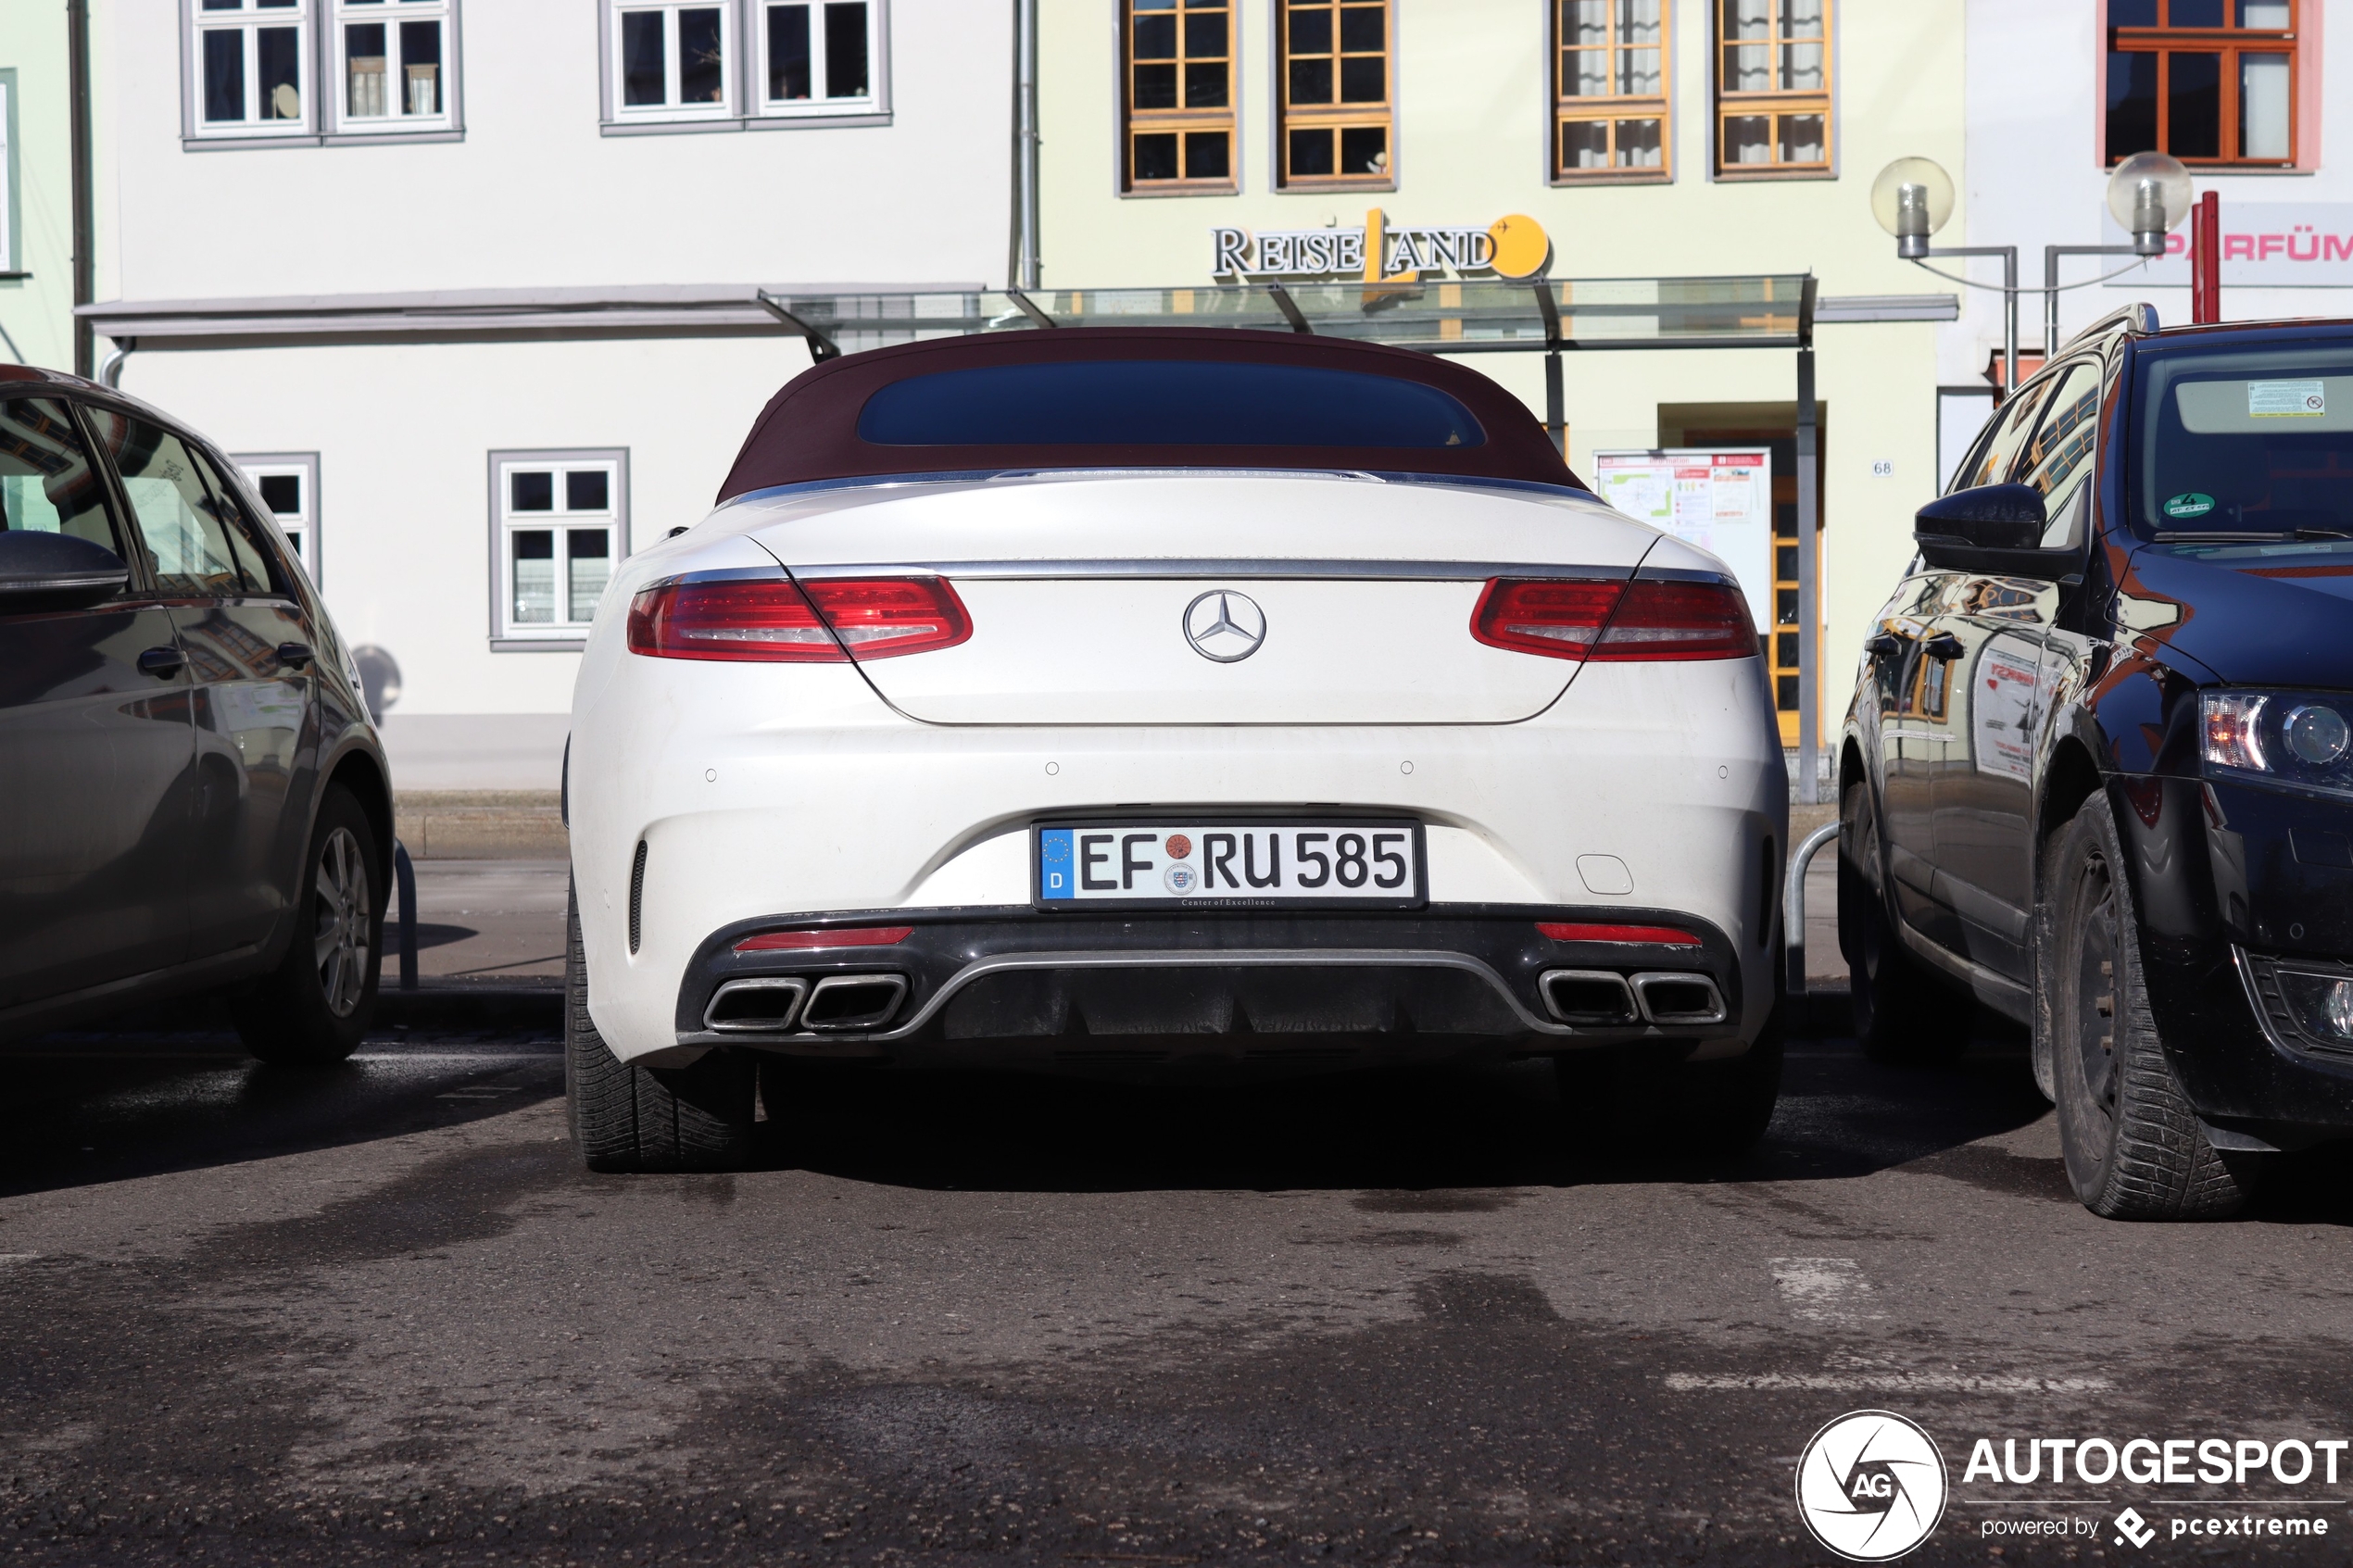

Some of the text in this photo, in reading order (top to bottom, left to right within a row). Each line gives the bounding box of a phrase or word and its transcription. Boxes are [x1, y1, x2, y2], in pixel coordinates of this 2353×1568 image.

[2155, 224, 2353, 261] PRFÜM
[1874, 463, 1891, 474] 68
[2182, 494, 2196, 505] 4
[1080, 834, 1157, 890] EF
[1203, 833, 1279, 889] RU
[1296, 833, 1405, 888] 585
[1051, 873, 1063, 888] D
